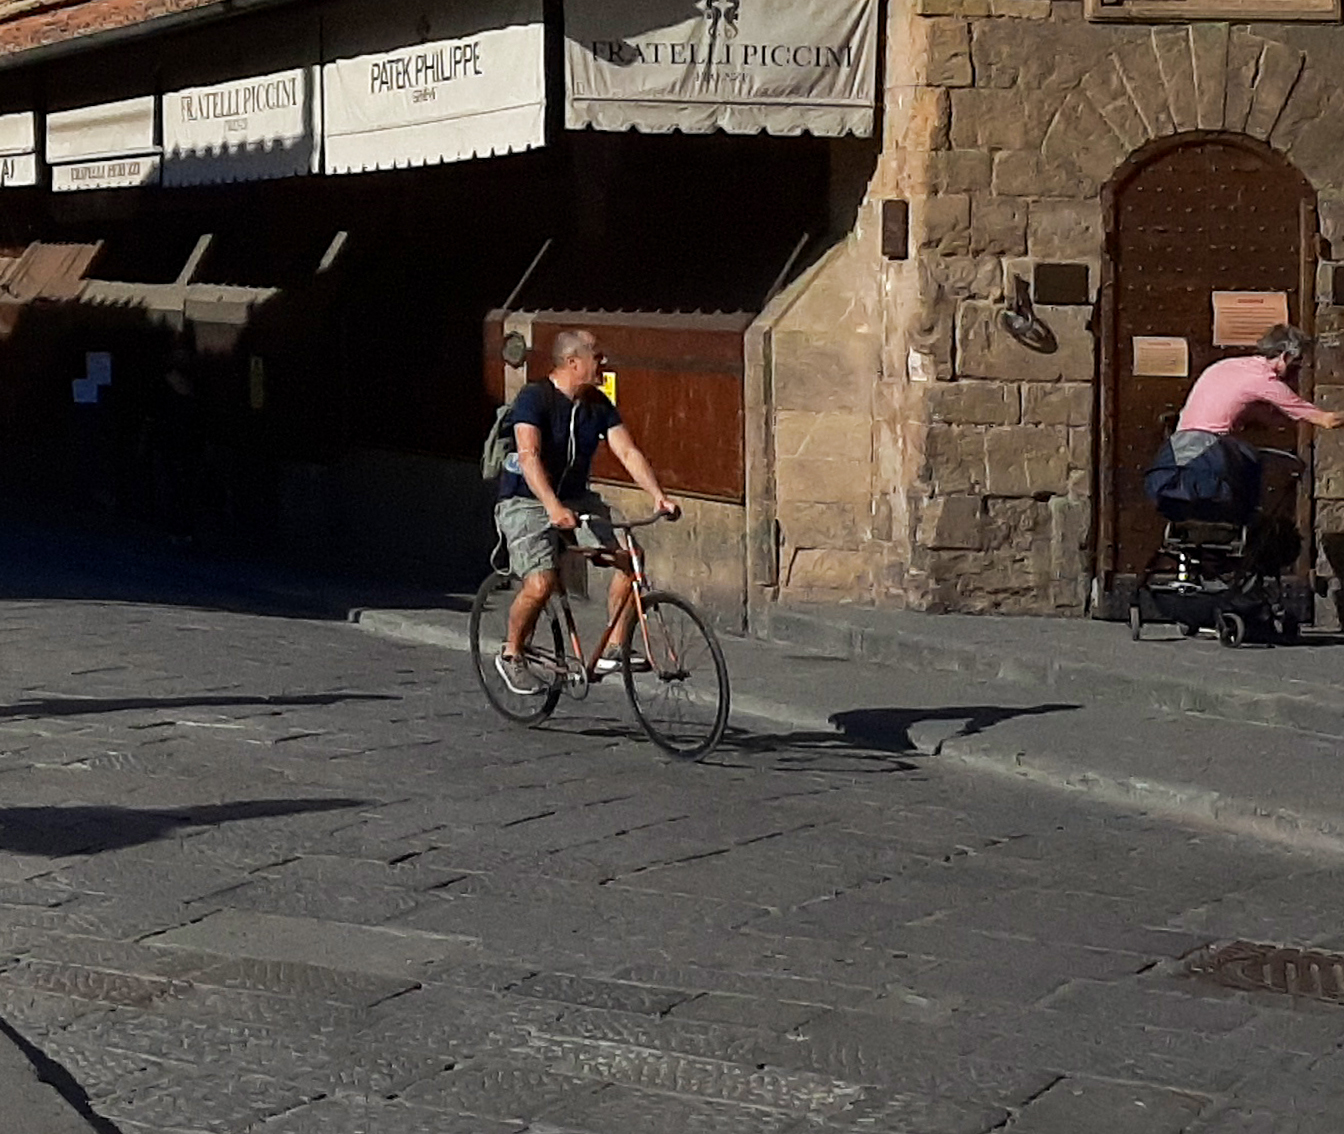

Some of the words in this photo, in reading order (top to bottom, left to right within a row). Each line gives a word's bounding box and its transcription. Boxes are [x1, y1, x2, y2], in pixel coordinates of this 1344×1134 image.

[370, 56, 413, 93] PATEK
[415, 41, 483, 85] PHILIPPE
[592, 40, 734, 66] FRATELLI
[740, 44, 853, 68] PICCINI
[181, 88, 240, 122] FRATELLI
[243, 77, 297, 113] PICCINI
